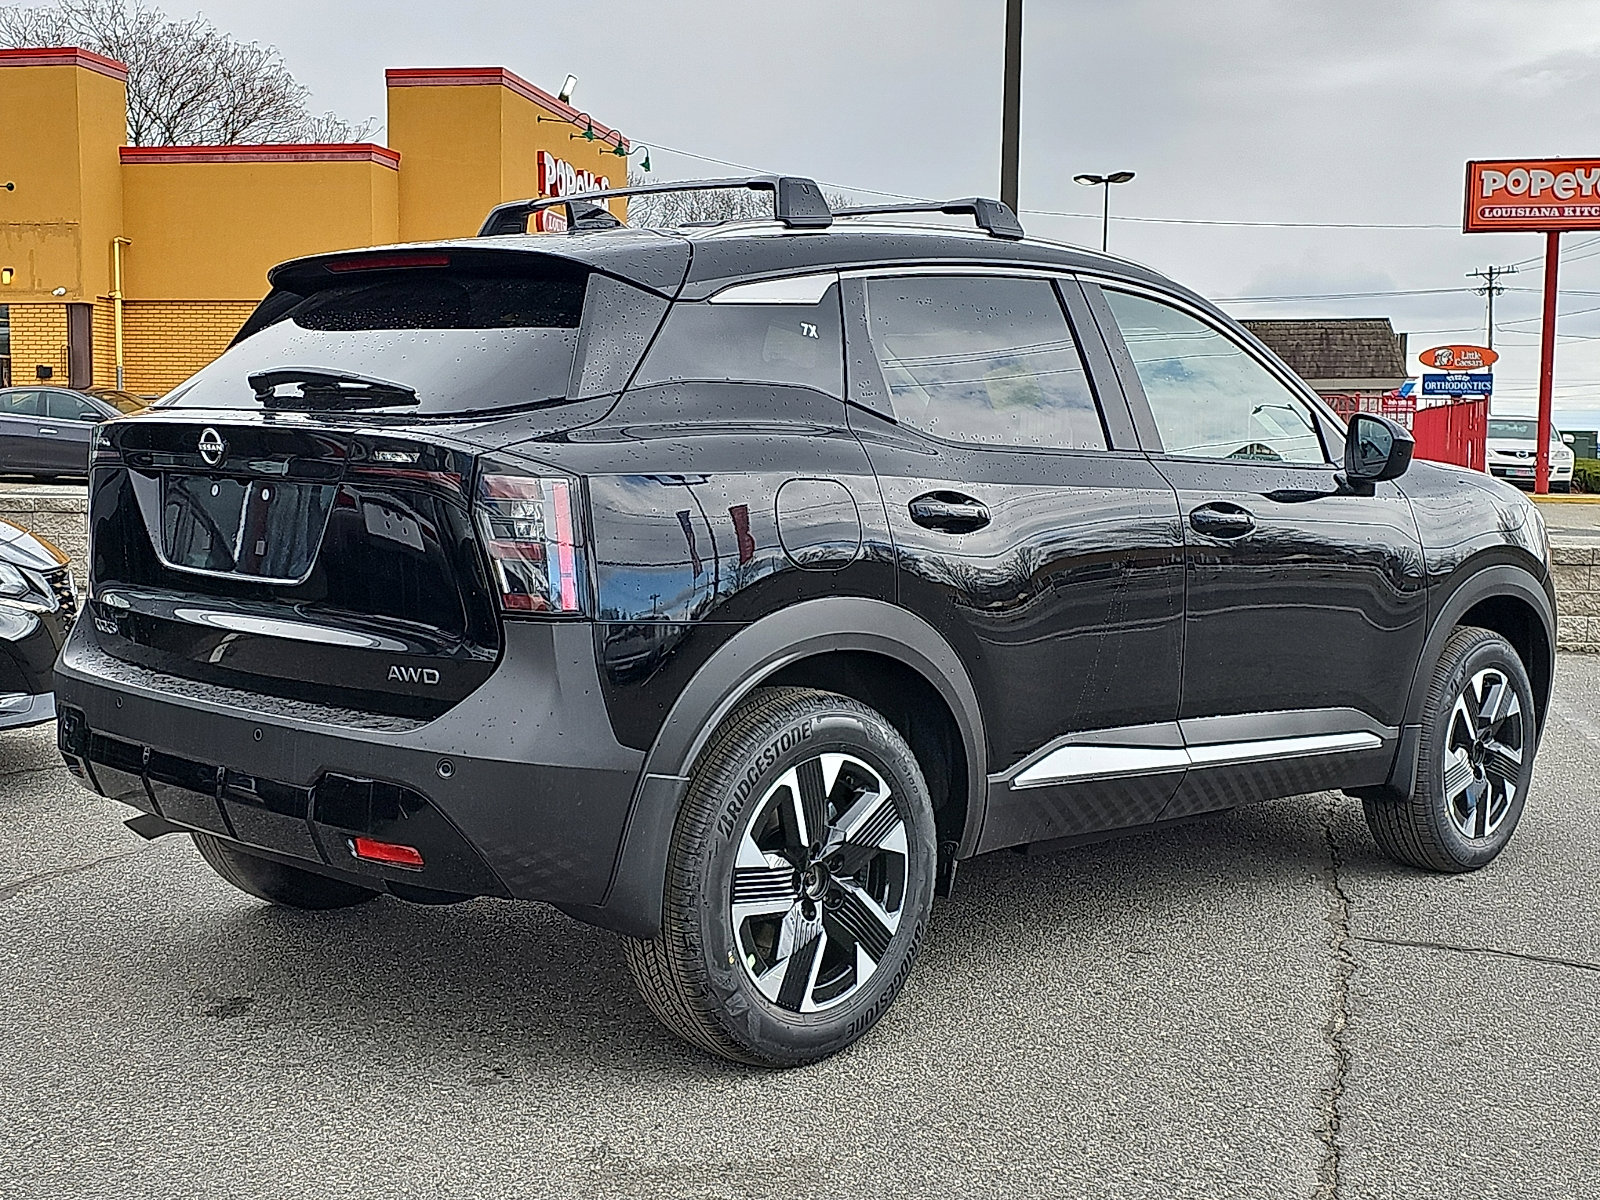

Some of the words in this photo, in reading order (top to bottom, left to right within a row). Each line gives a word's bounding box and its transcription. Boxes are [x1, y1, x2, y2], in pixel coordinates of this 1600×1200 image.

[1481, 168, 1600, 199] POPeY
[1483, 206, 1559, 218] LOUISIANA
[1563, 206, 1600, 217] KITC
[1461, 350, 1482, 360] Little
[1454, 359, 1485, 367] Caesars
[1424, 381, 1492, 391] ORTHODONTICS
[387, 665, 440, 685] AWD
[717, 720, 812, 841] BRIDGESTONE
